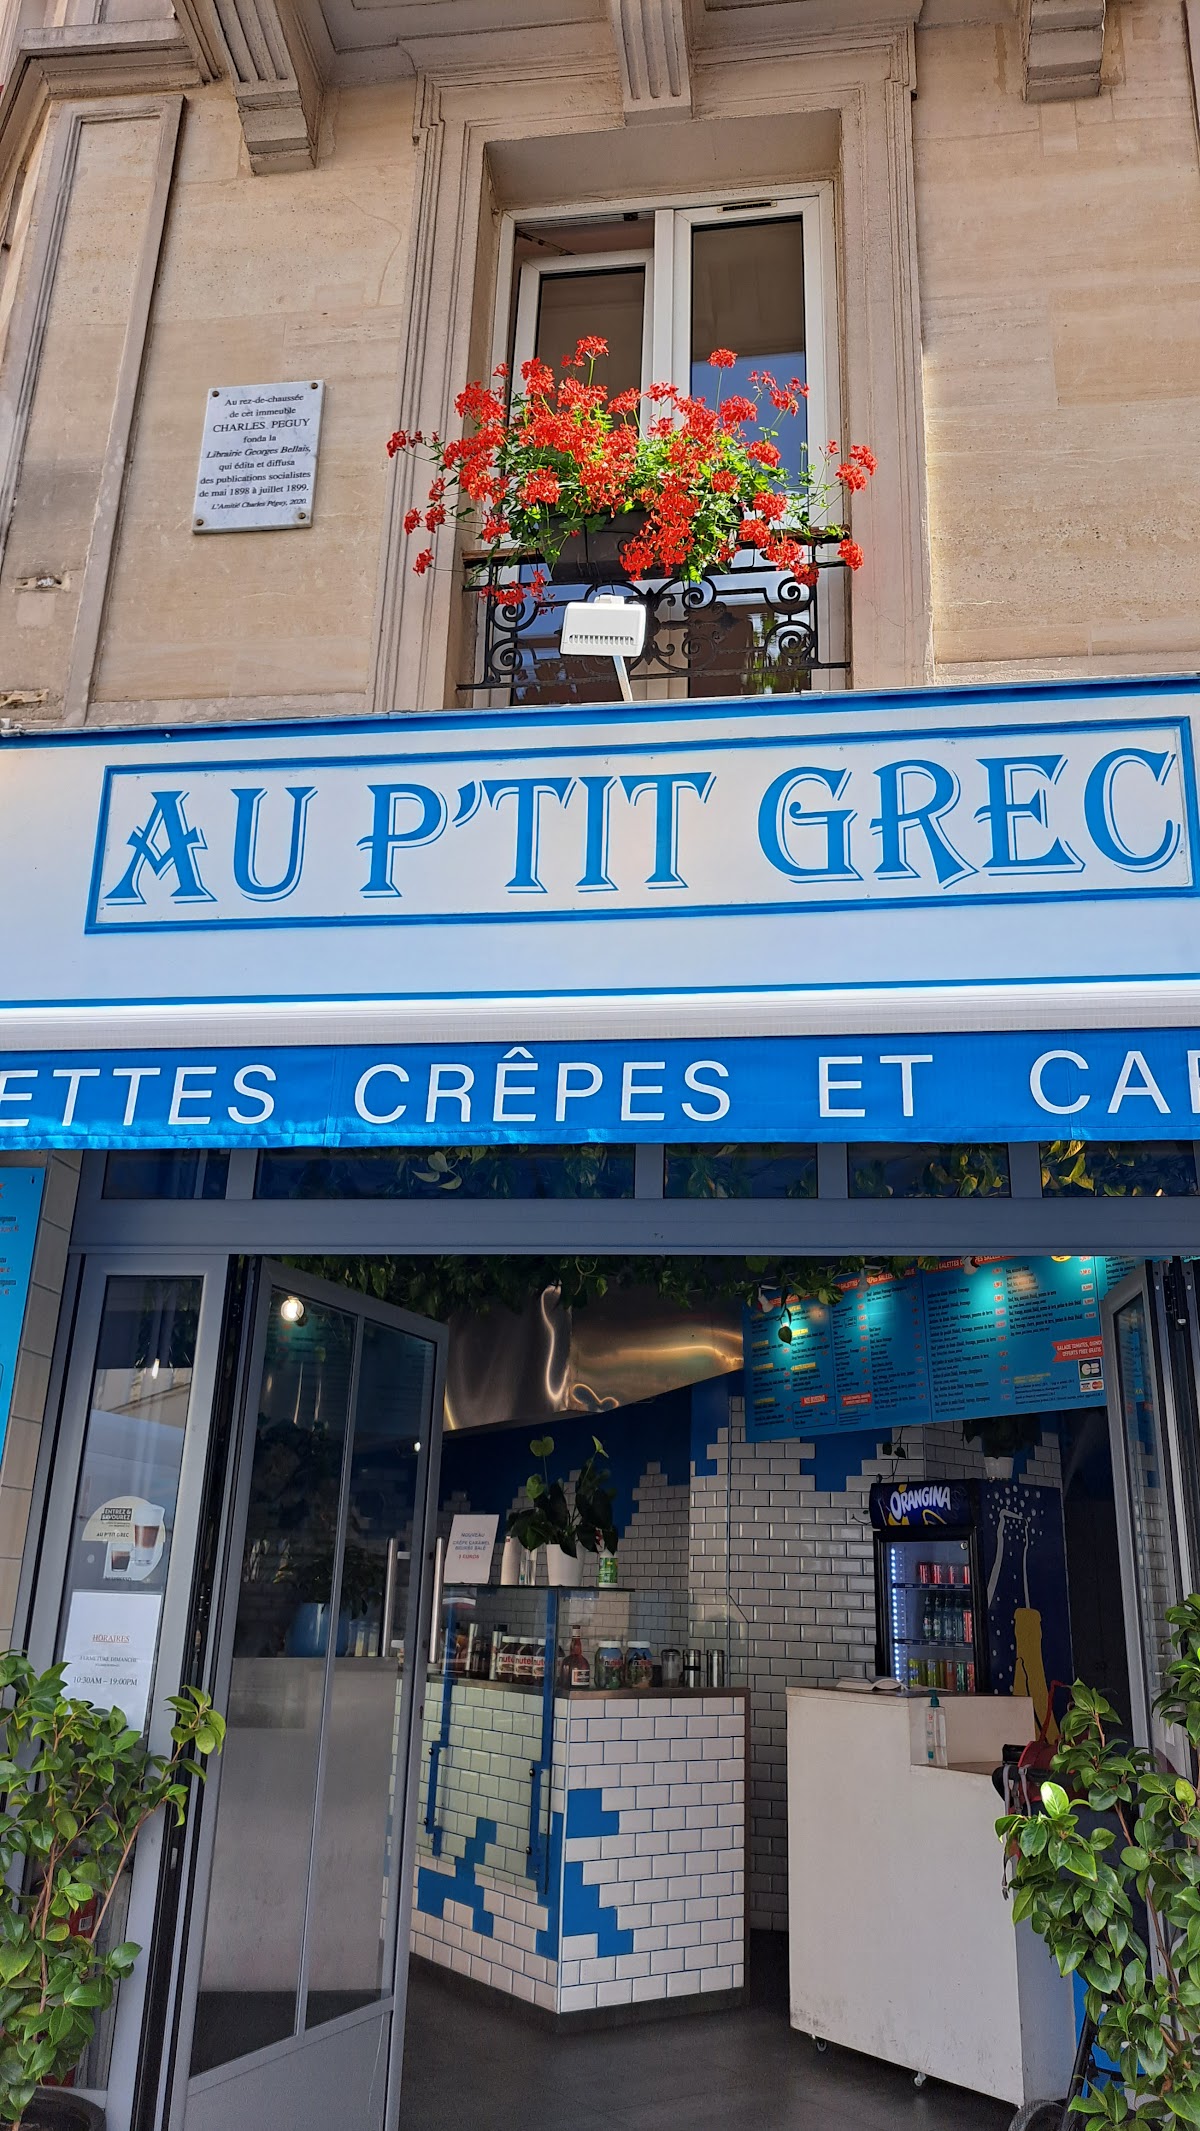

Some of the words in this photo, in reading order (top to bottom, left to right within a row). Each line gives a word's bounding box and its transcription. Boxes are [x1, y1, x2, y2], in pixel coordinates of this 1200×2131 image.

[225, 398, 237, 406] Au
[239, 394, 304, 406] rez-de-chaussée
[241, 410, 253, 418] cet
[256, 407, 297, 416] immeuble
[213, 421, 266, 433] CHARLES
[271, 418, 310, 429] PEGUY
[243, 435, 267, 443] fonda
[206, 450, 243, 459] Librairie
[244, 448, 279, 457] Georges
[280, 445, 311, 454] Bellais,
[219, 463, 232, 472] qui
[234, 461, 255, 470] édita
[266, 459, 295, 467] diffusa
[216, 473, 266, 486] publications
[268, 471, 311, 480] socialistes
[199, 490, 209, 498] de
[211, 488, 227, 496] mai
[230, 487, 250, 496] 1898
[252, 486, 257, 495] à
[258, 485, 283, 496] juillet
[287, 484, 309, 493] 1899.
[102, 786, 318, 905] AU
[357, 771, 717, 899] P'TIT
[757, 747, 1181, 889] GREC
[0, 1064, 277, 1127] ETTES
[354, 1046, 730, 1125] CRÊPES
[819, 1053, 934, 1118] ET
[890, 1485, 952, 1520] ORANGINA
[92, 1634, 130, 1643] HORAIRES
[73, 1676, 102, 1685] 10:30AM
[110, 1677, 138, 1686] 19:00PM
